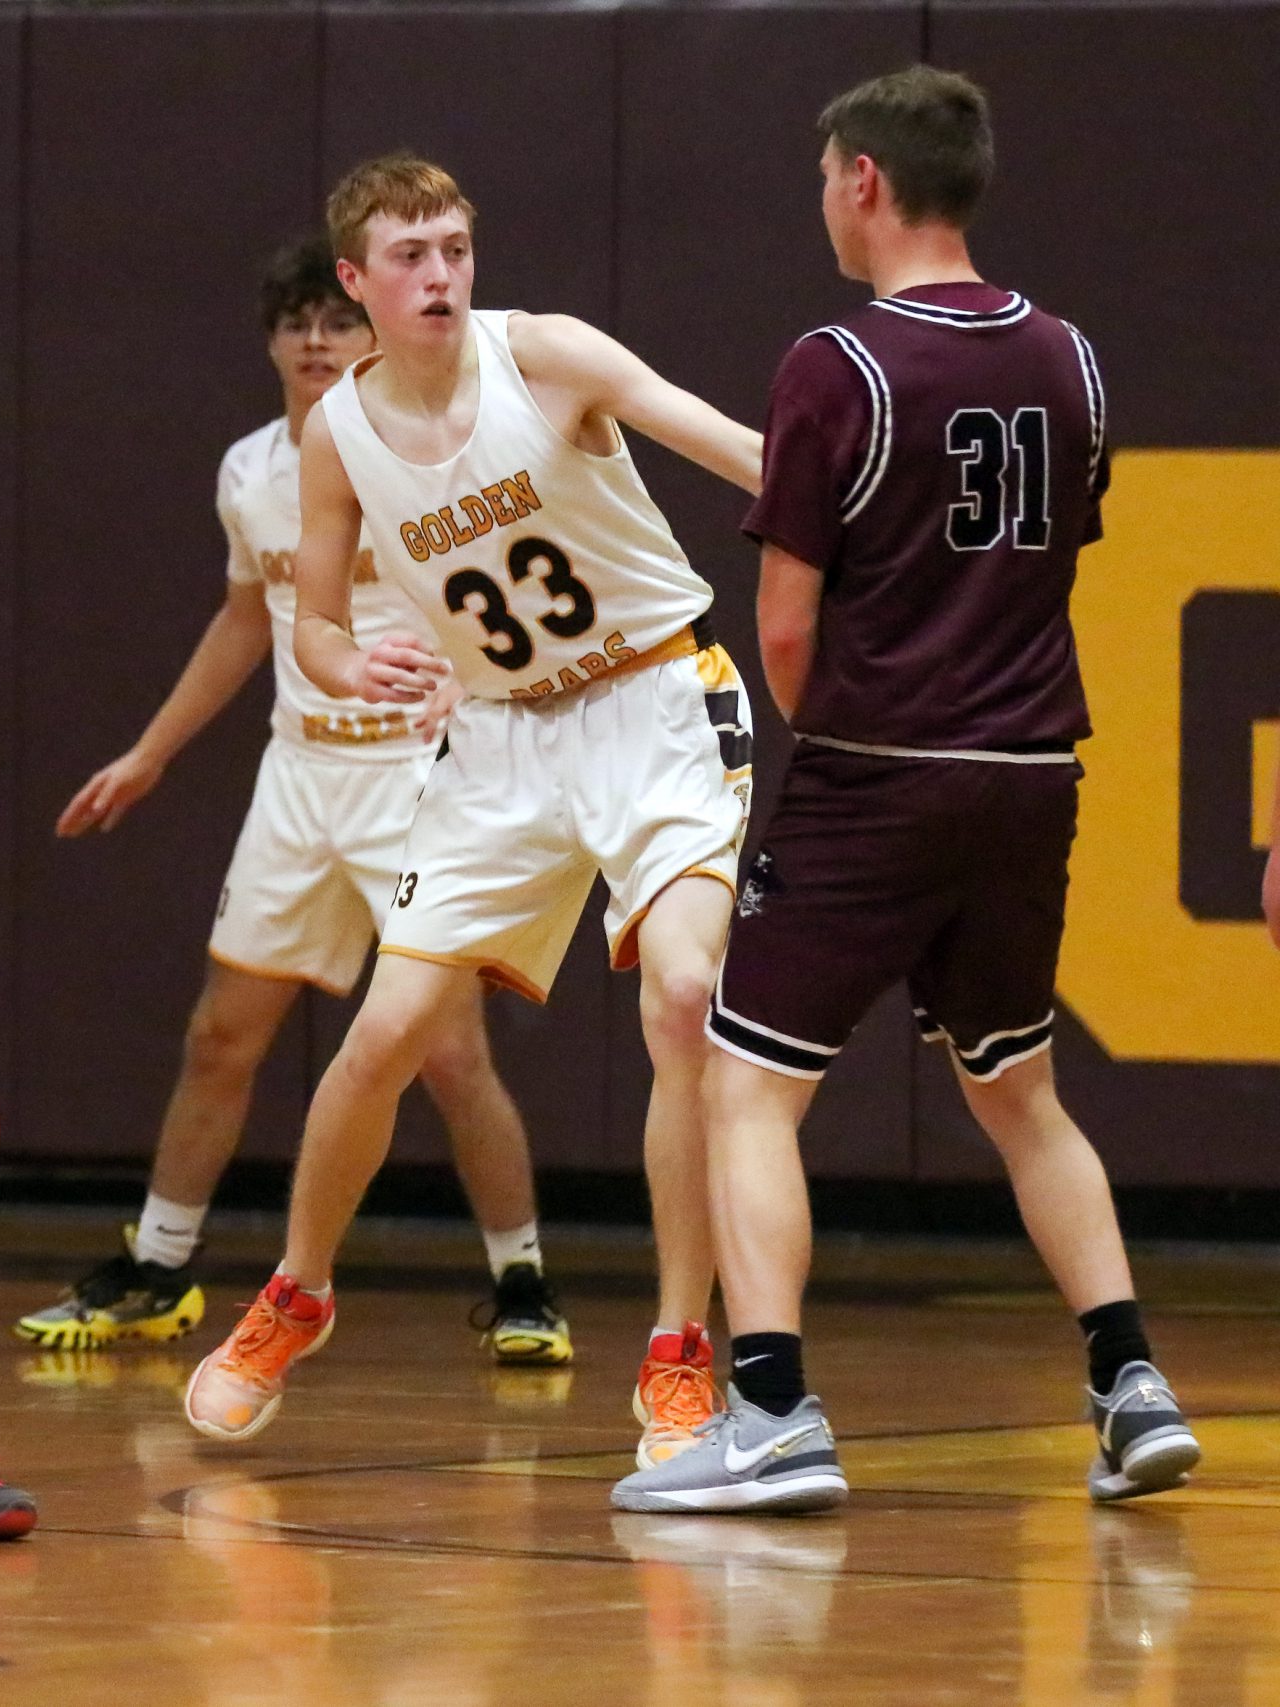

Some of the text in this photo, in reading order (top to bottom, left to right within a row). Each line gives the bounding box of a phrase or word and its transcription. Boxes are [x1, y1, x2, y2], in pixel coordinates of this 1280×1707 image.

[399, 469, 543, 563] GOLDEN
[945, 407, 1052, 552] 31
[442, 536, 597, 671] 33
